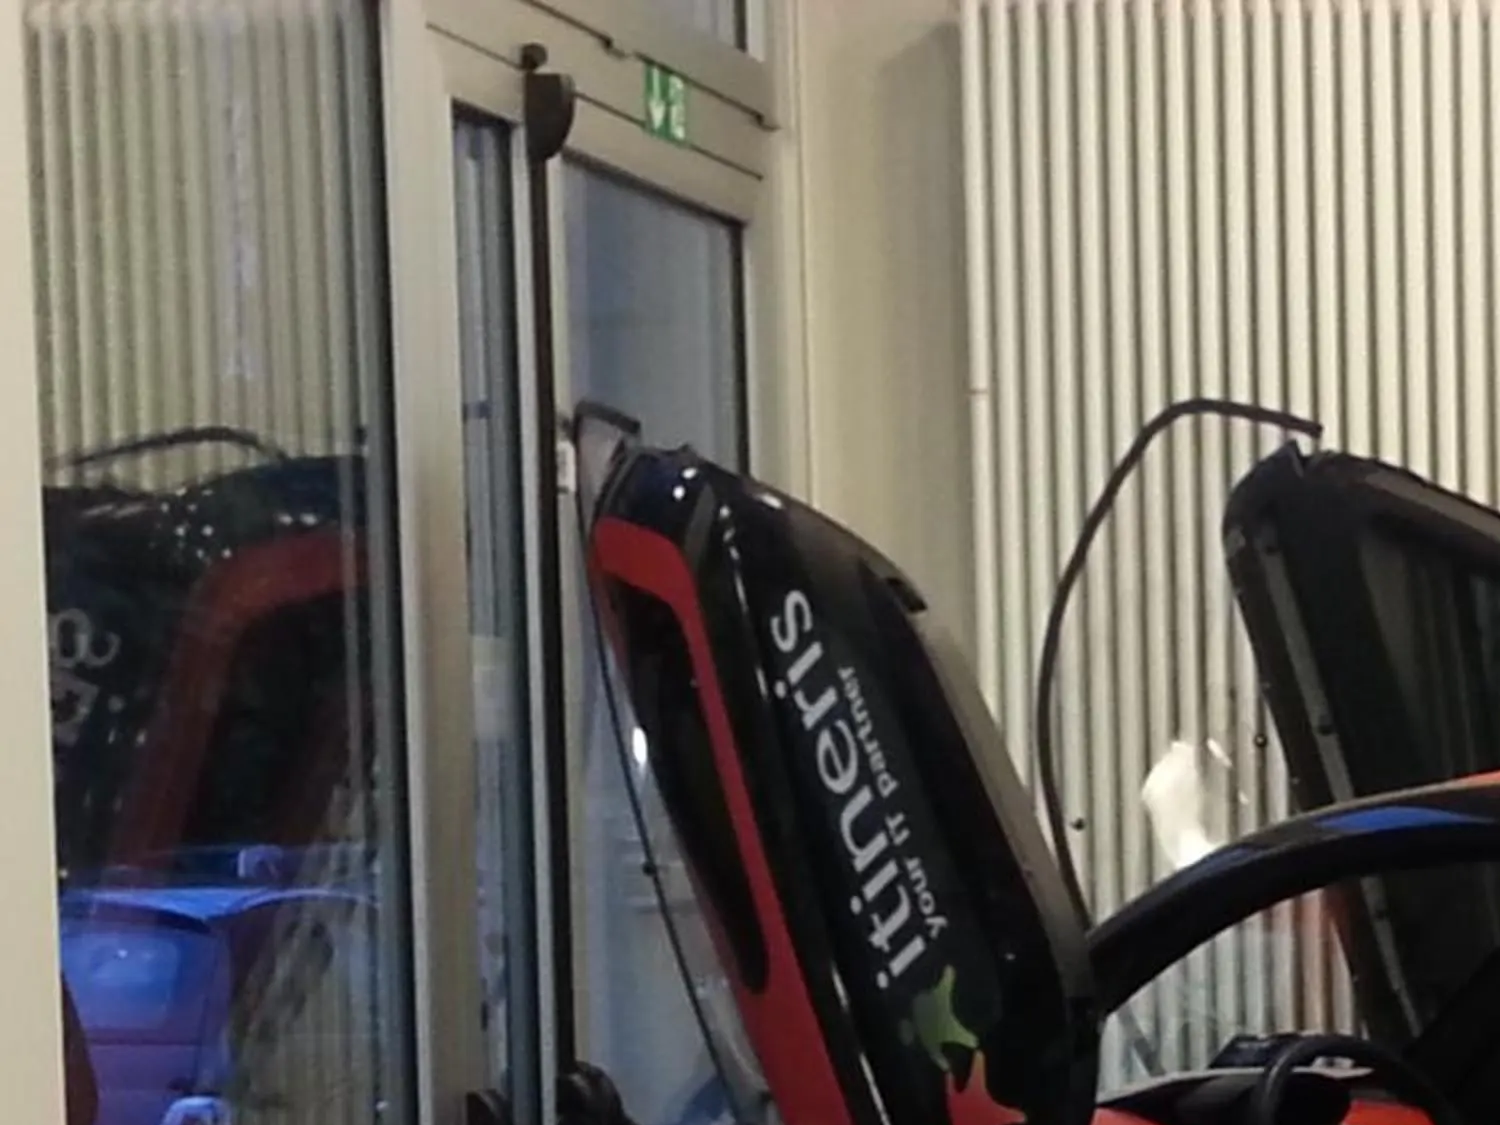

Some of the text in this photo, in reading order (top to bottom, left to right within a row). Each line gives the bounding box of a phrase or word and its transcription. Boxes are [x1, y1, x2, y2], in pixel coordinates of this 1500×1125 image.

[771, 590, 926, 989] itineris
[837, 666, 899, 798] partner
[903, 856, 948, 940] your
